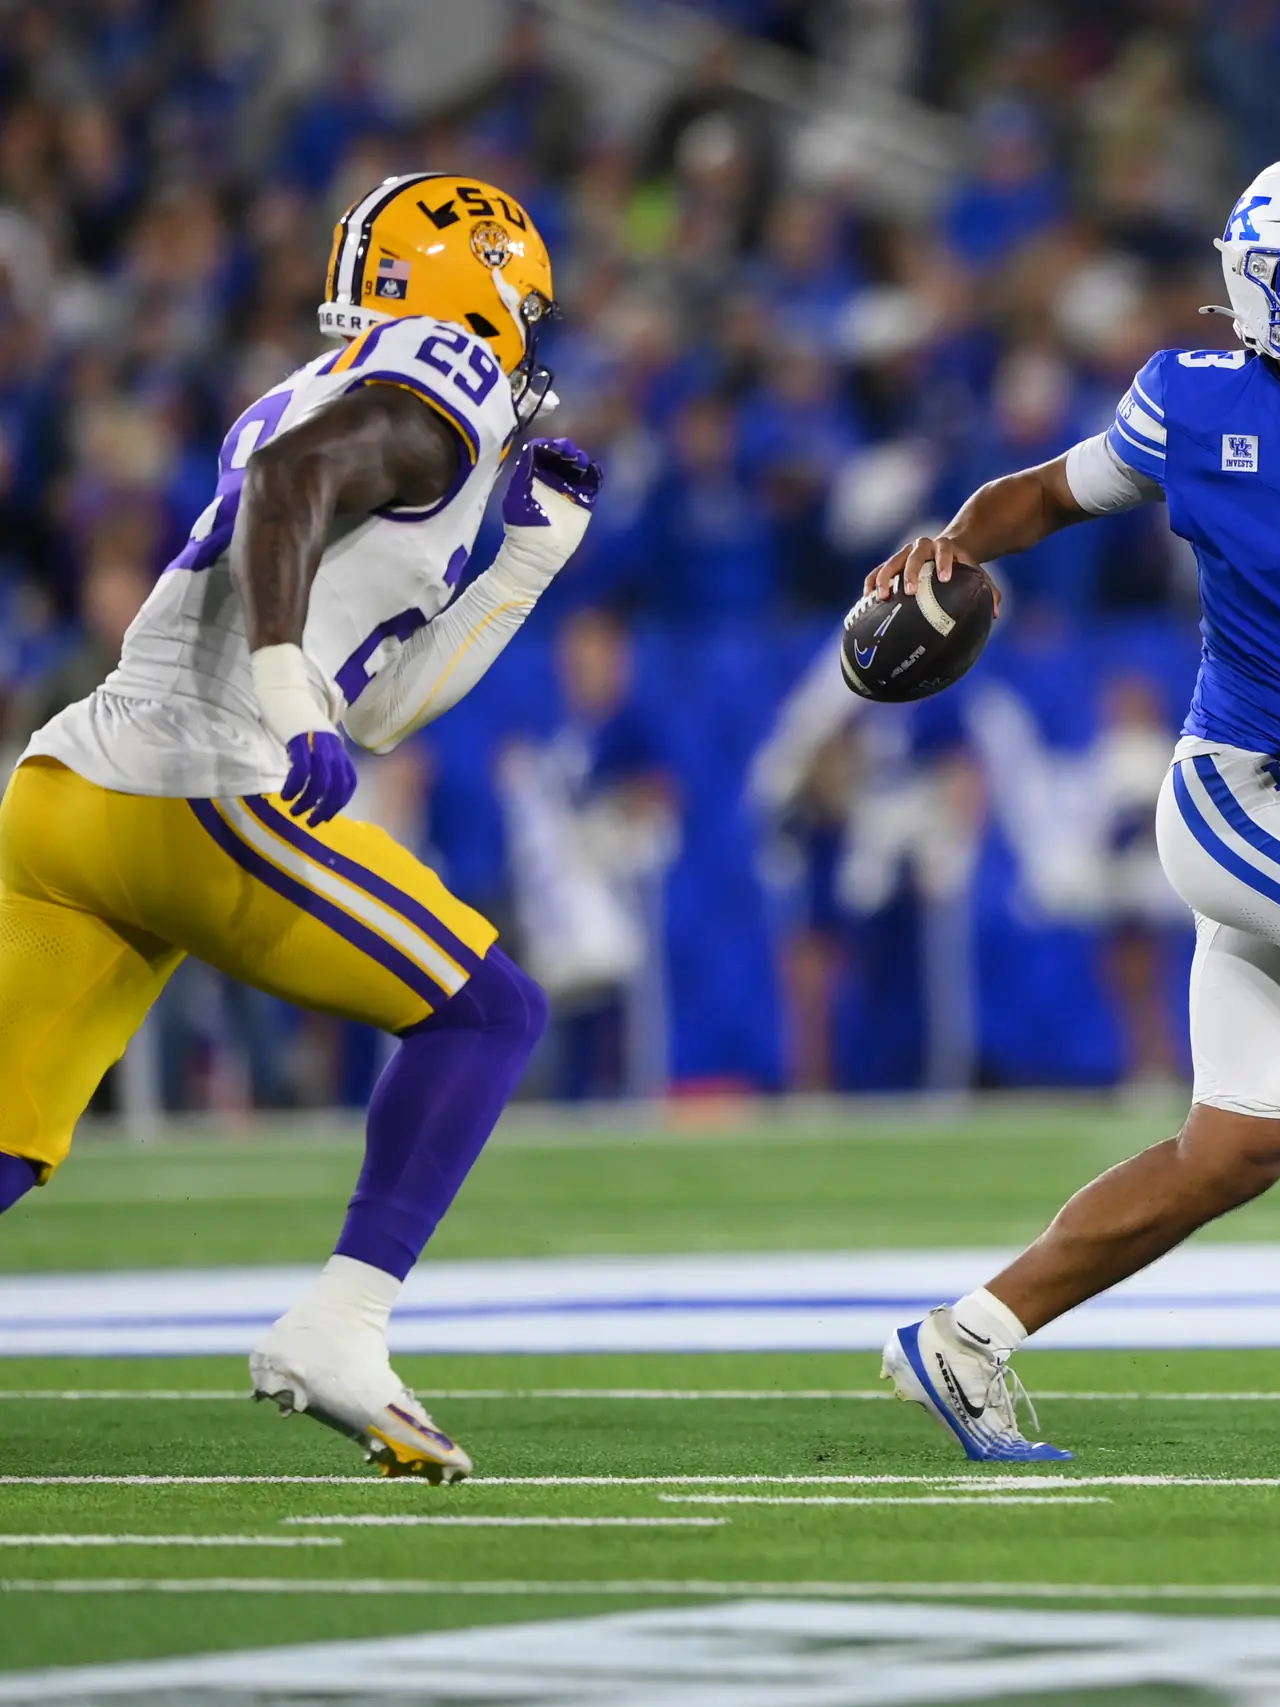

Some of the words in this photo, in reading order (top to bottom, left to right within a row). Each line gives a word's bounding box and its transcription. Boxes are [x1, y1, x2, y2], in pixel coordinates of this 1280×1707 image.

[416, 187, 526, 231] LSU
[1223, 196, 1272, 242] K
[364, 280, 373, 295] 9
[317, 312, 379, 330] IGER
[414, 325, 499, 406] 29
[1178, 349, 1246, 370] 3
[1228, 437, 1252, 458] UK
[1226, 459, 1253, 468] INVESTS
[935, 1352, 955, 1393] AIR
